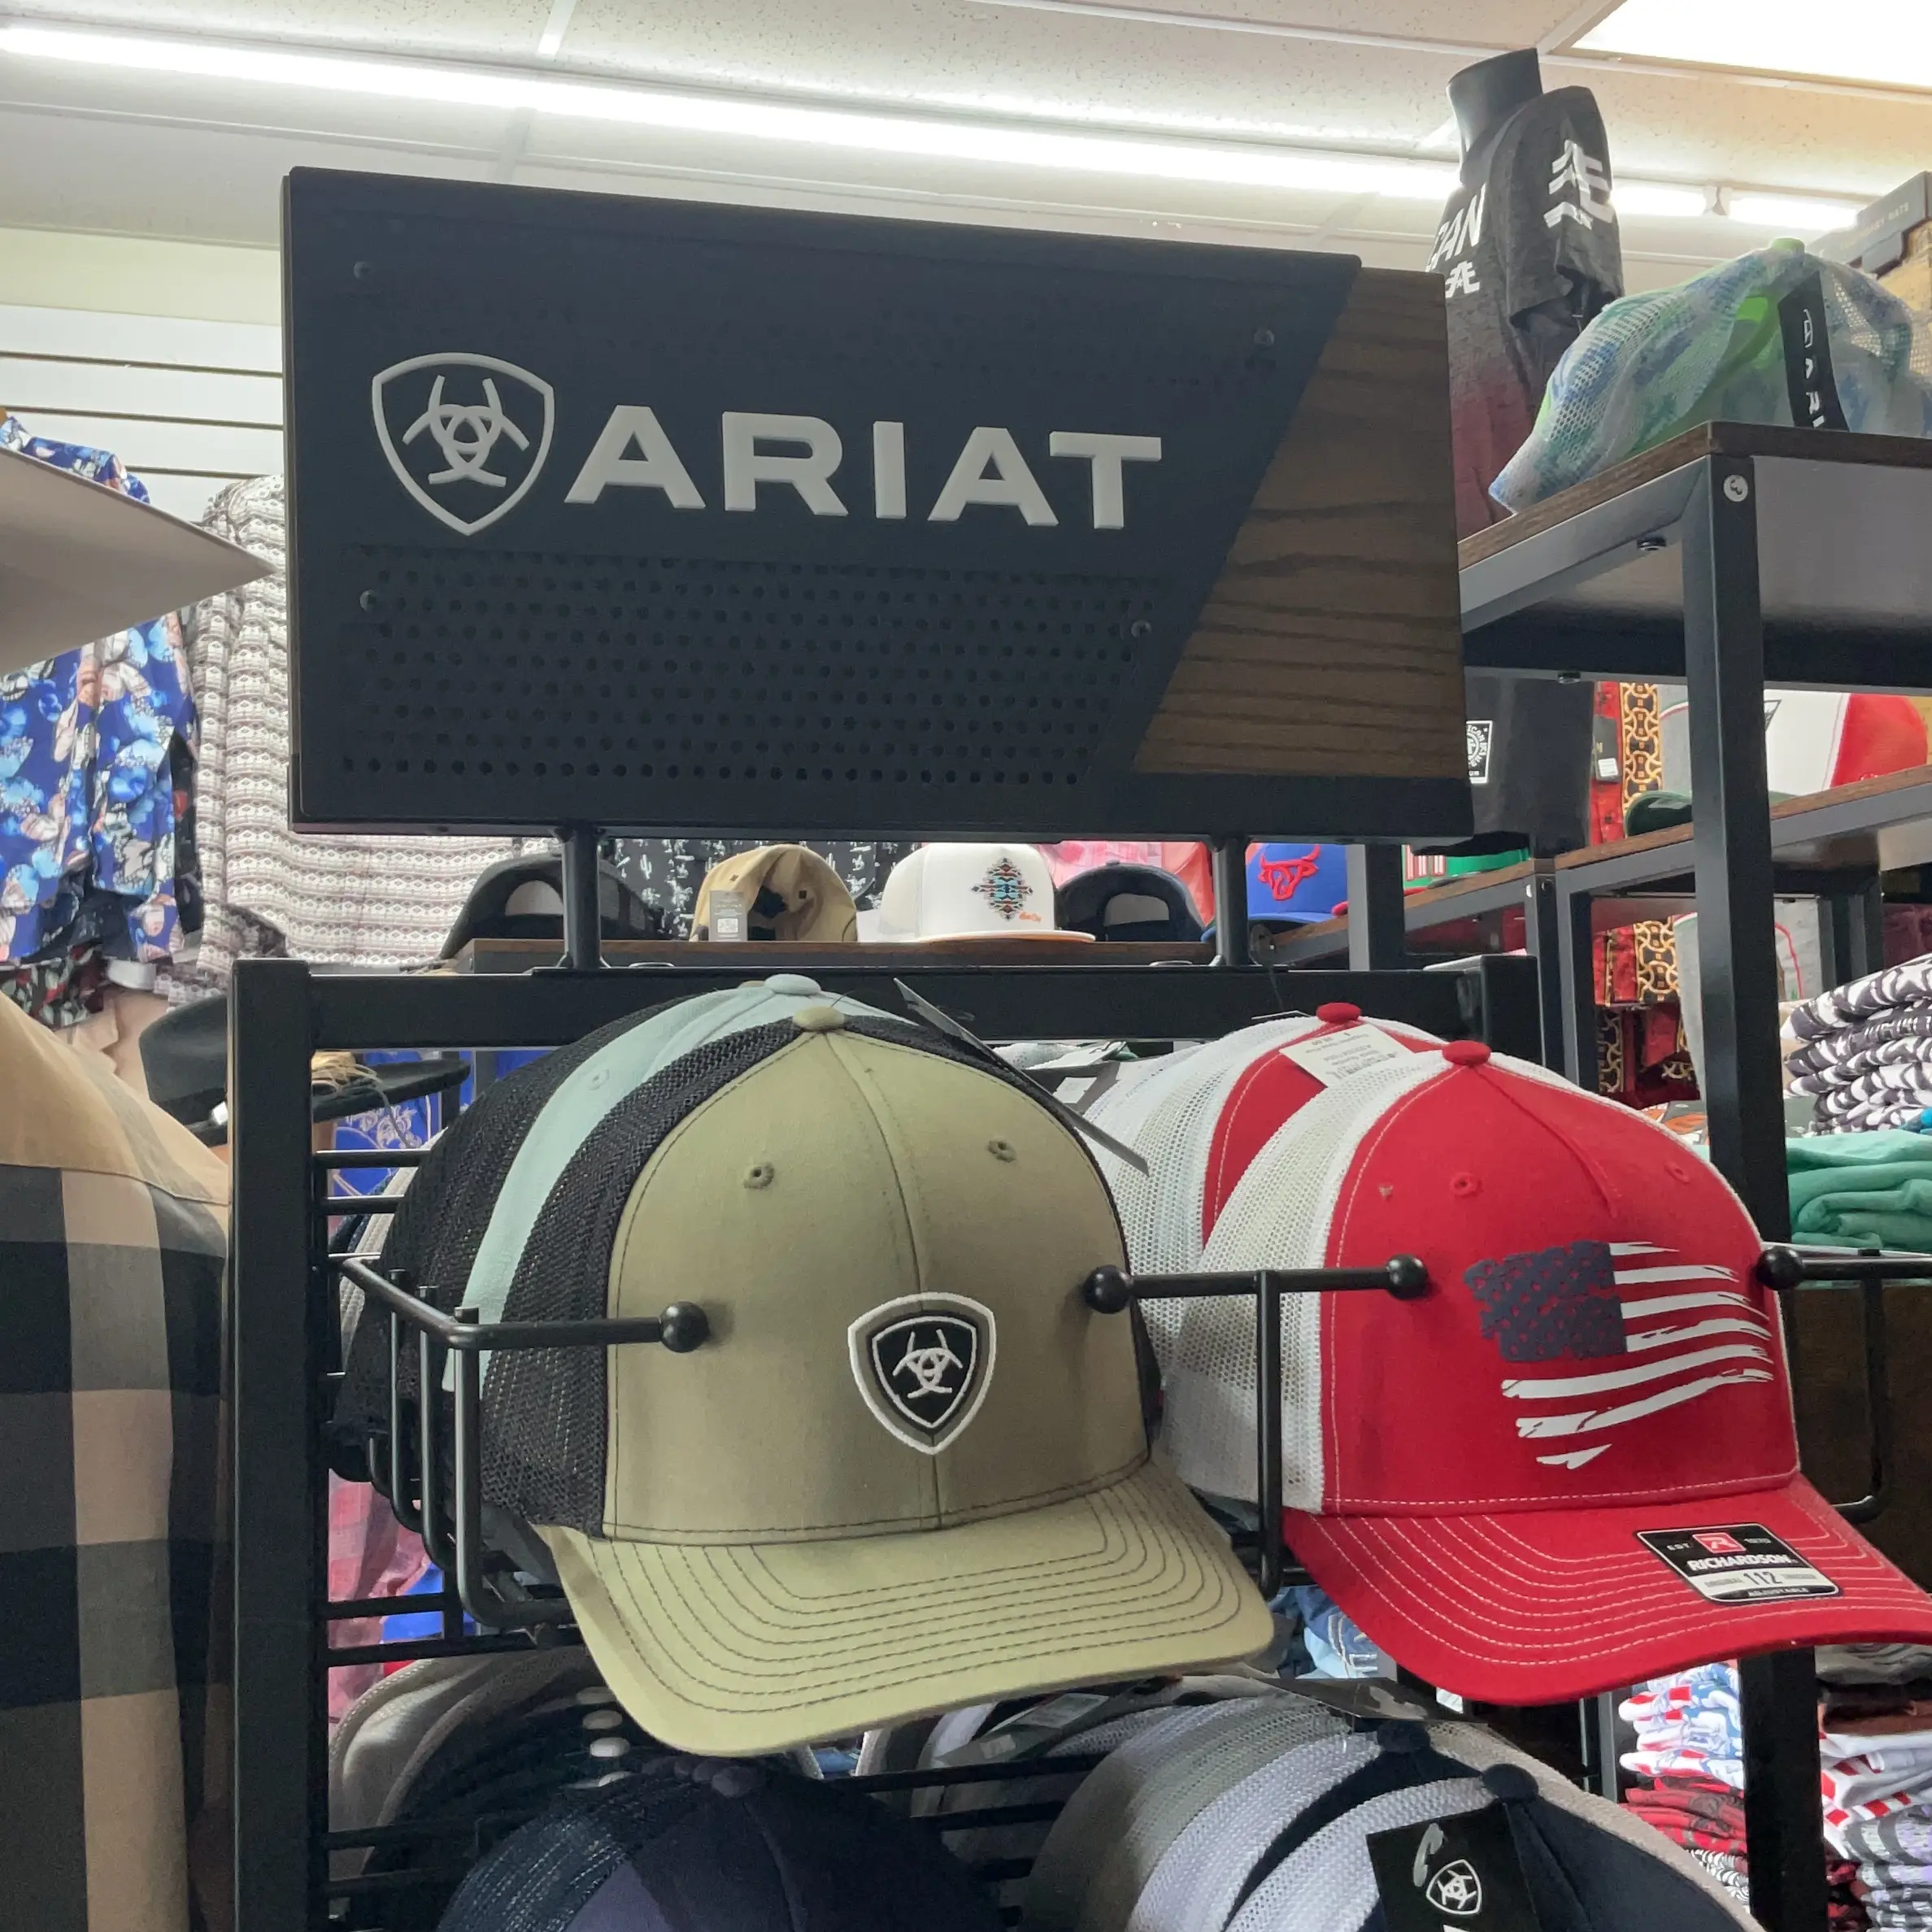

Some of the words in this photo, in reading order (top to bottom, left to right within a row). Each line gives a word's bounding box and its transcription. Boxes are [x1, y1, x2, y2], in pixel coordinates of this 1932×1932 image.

[564, 404, 1162, 530] ARIAT
[1686, 1554, 1792, 1571] RICHARDSON
[1743, 1571, 1783, 1586] 112
